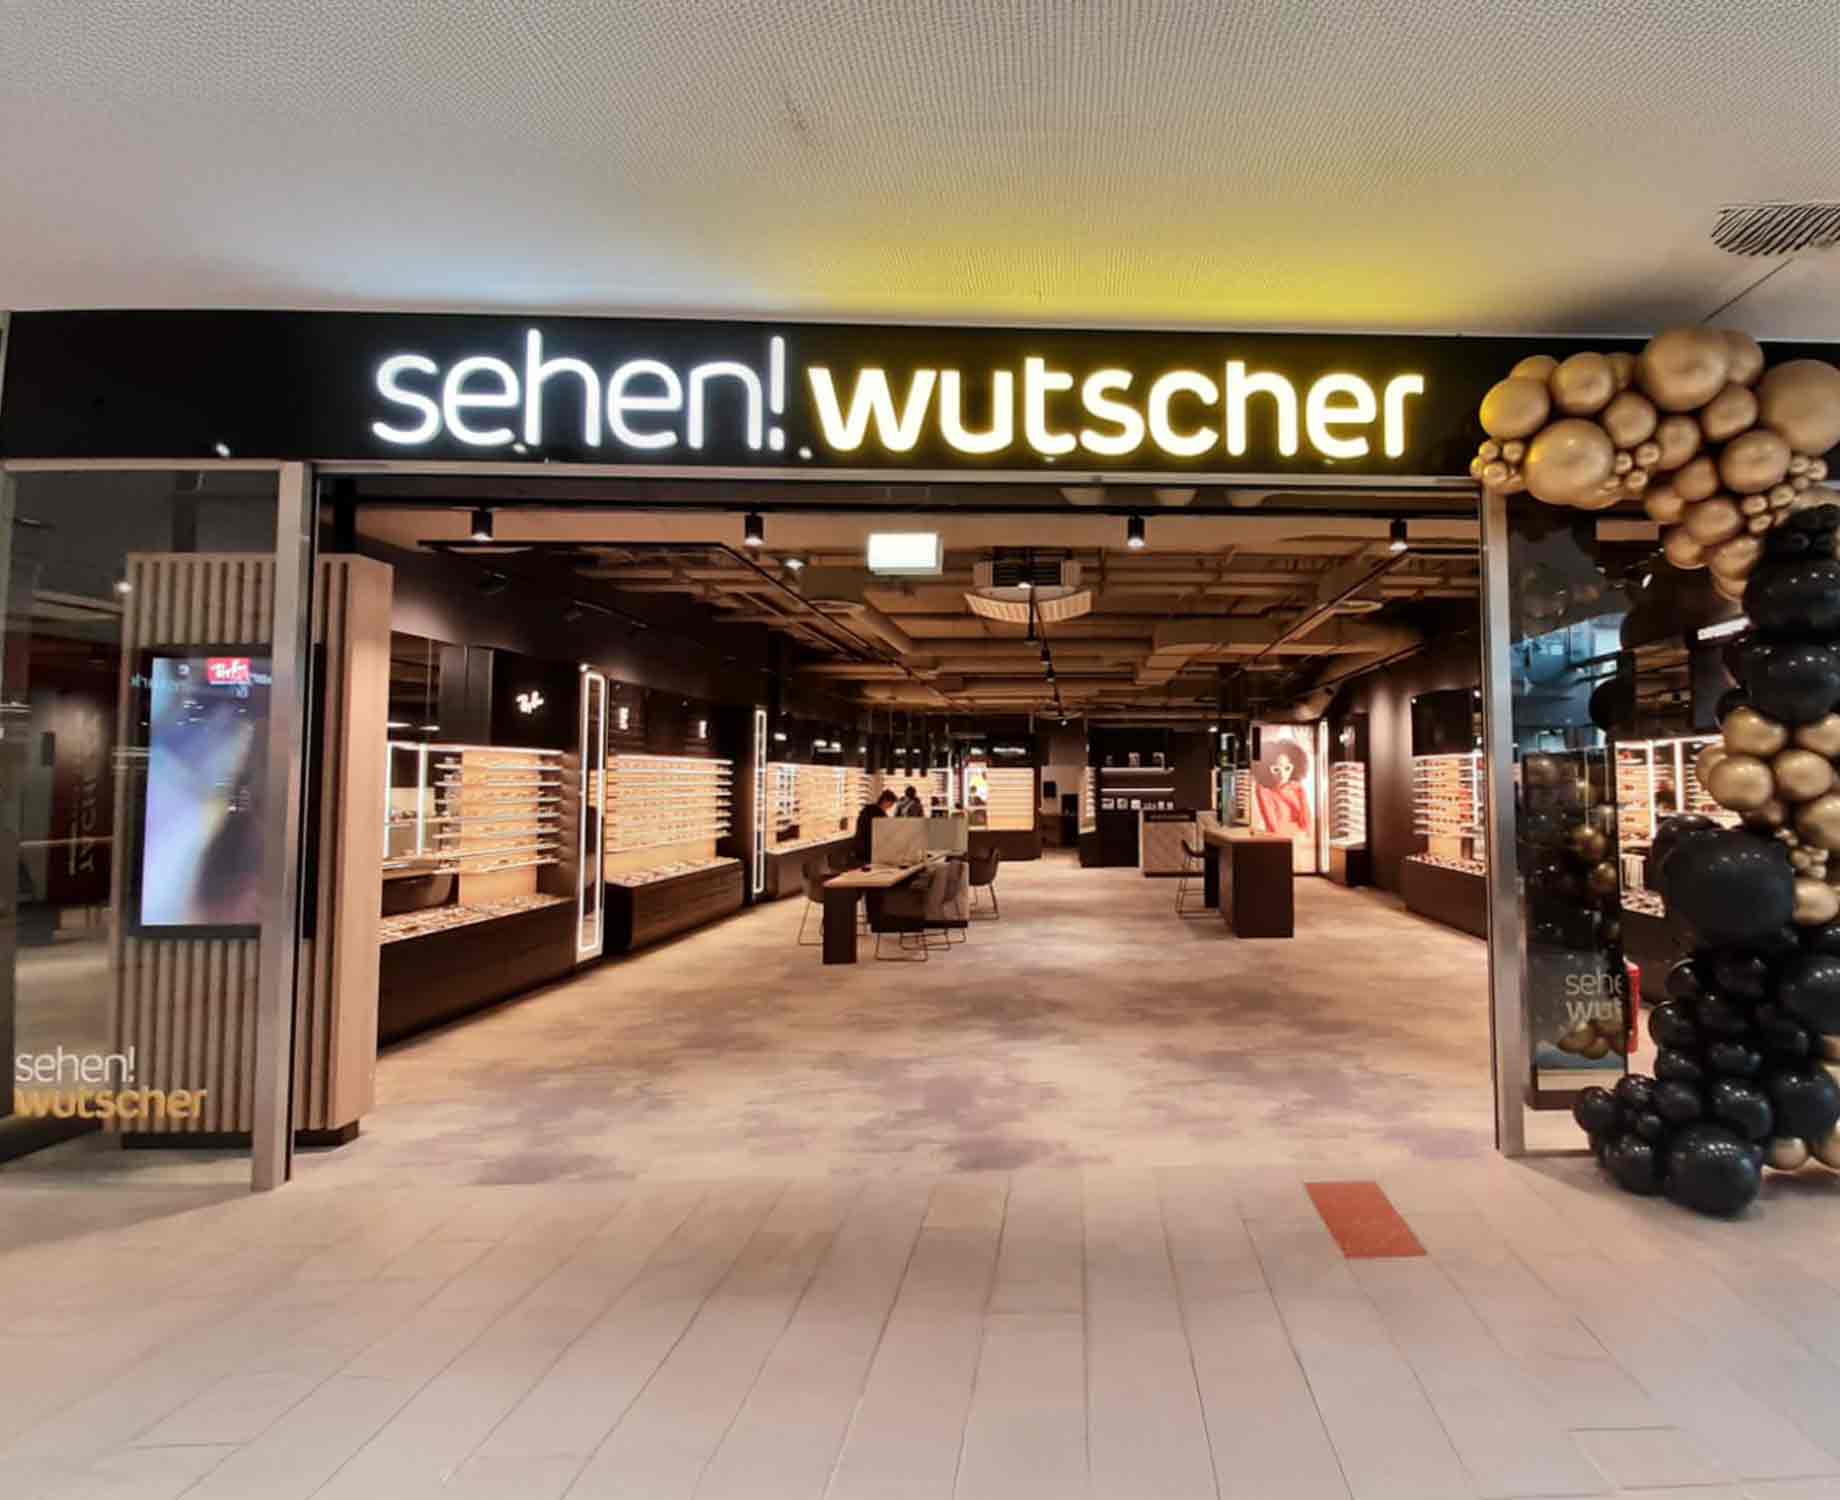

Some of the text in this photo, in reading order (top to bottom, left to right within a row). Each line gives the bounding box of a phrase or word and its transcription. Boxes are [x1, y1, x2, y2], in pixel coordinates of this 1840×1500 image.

[372, 328, 1425, 459] sehen! wutscher
[15, 1046, 135, 1083] sehen!
[14, 1086, 208, 1119] wutscher
